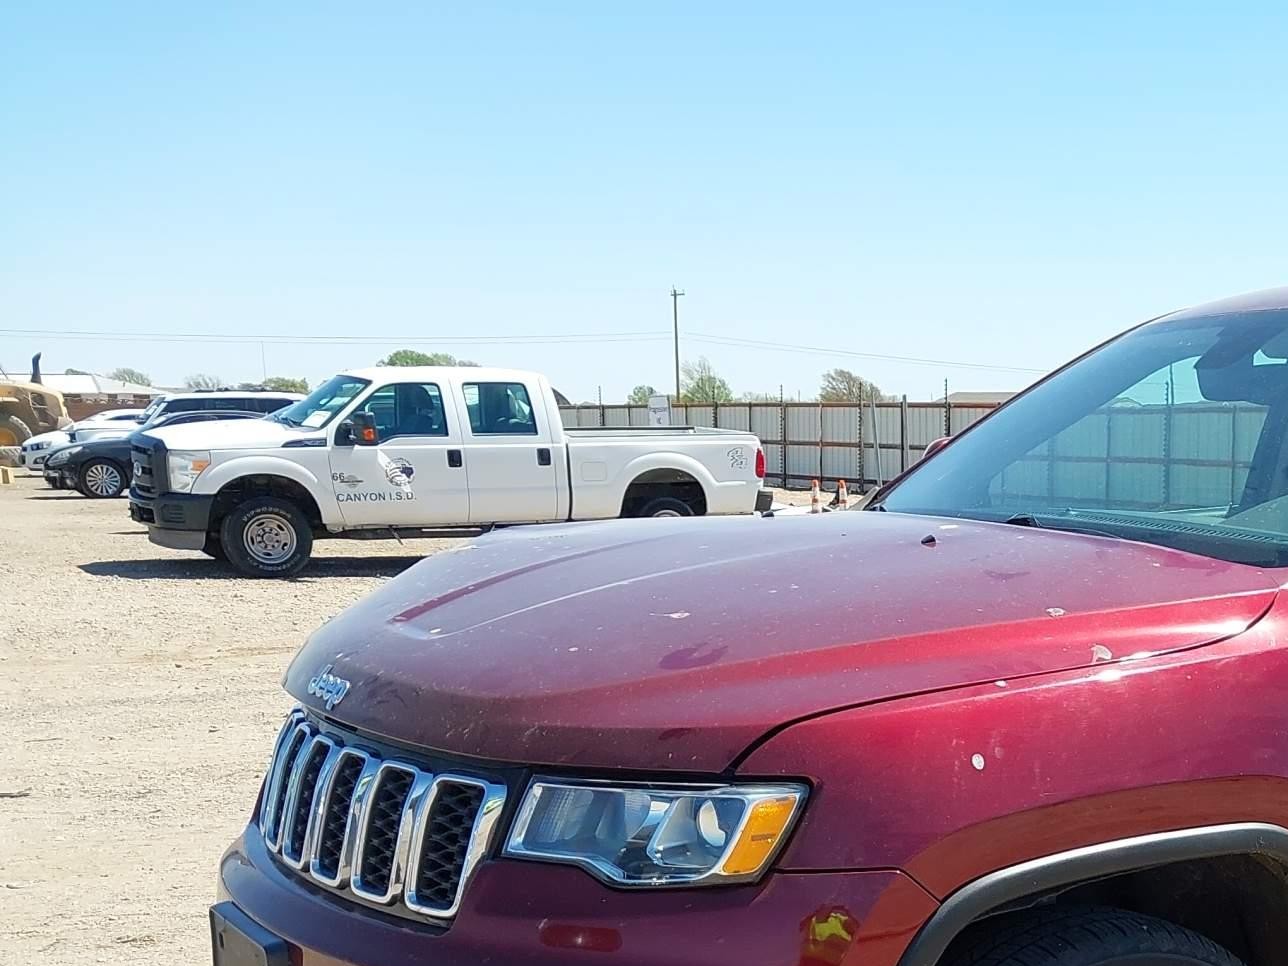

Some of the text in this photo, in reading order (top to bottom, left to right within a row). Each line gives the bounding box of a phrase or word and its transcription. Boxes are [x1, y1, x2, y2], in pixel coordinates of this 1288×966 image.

[336, 491, 417, 502] CANYON I.S.D.
[308, 664, 350, 711] Jeep
